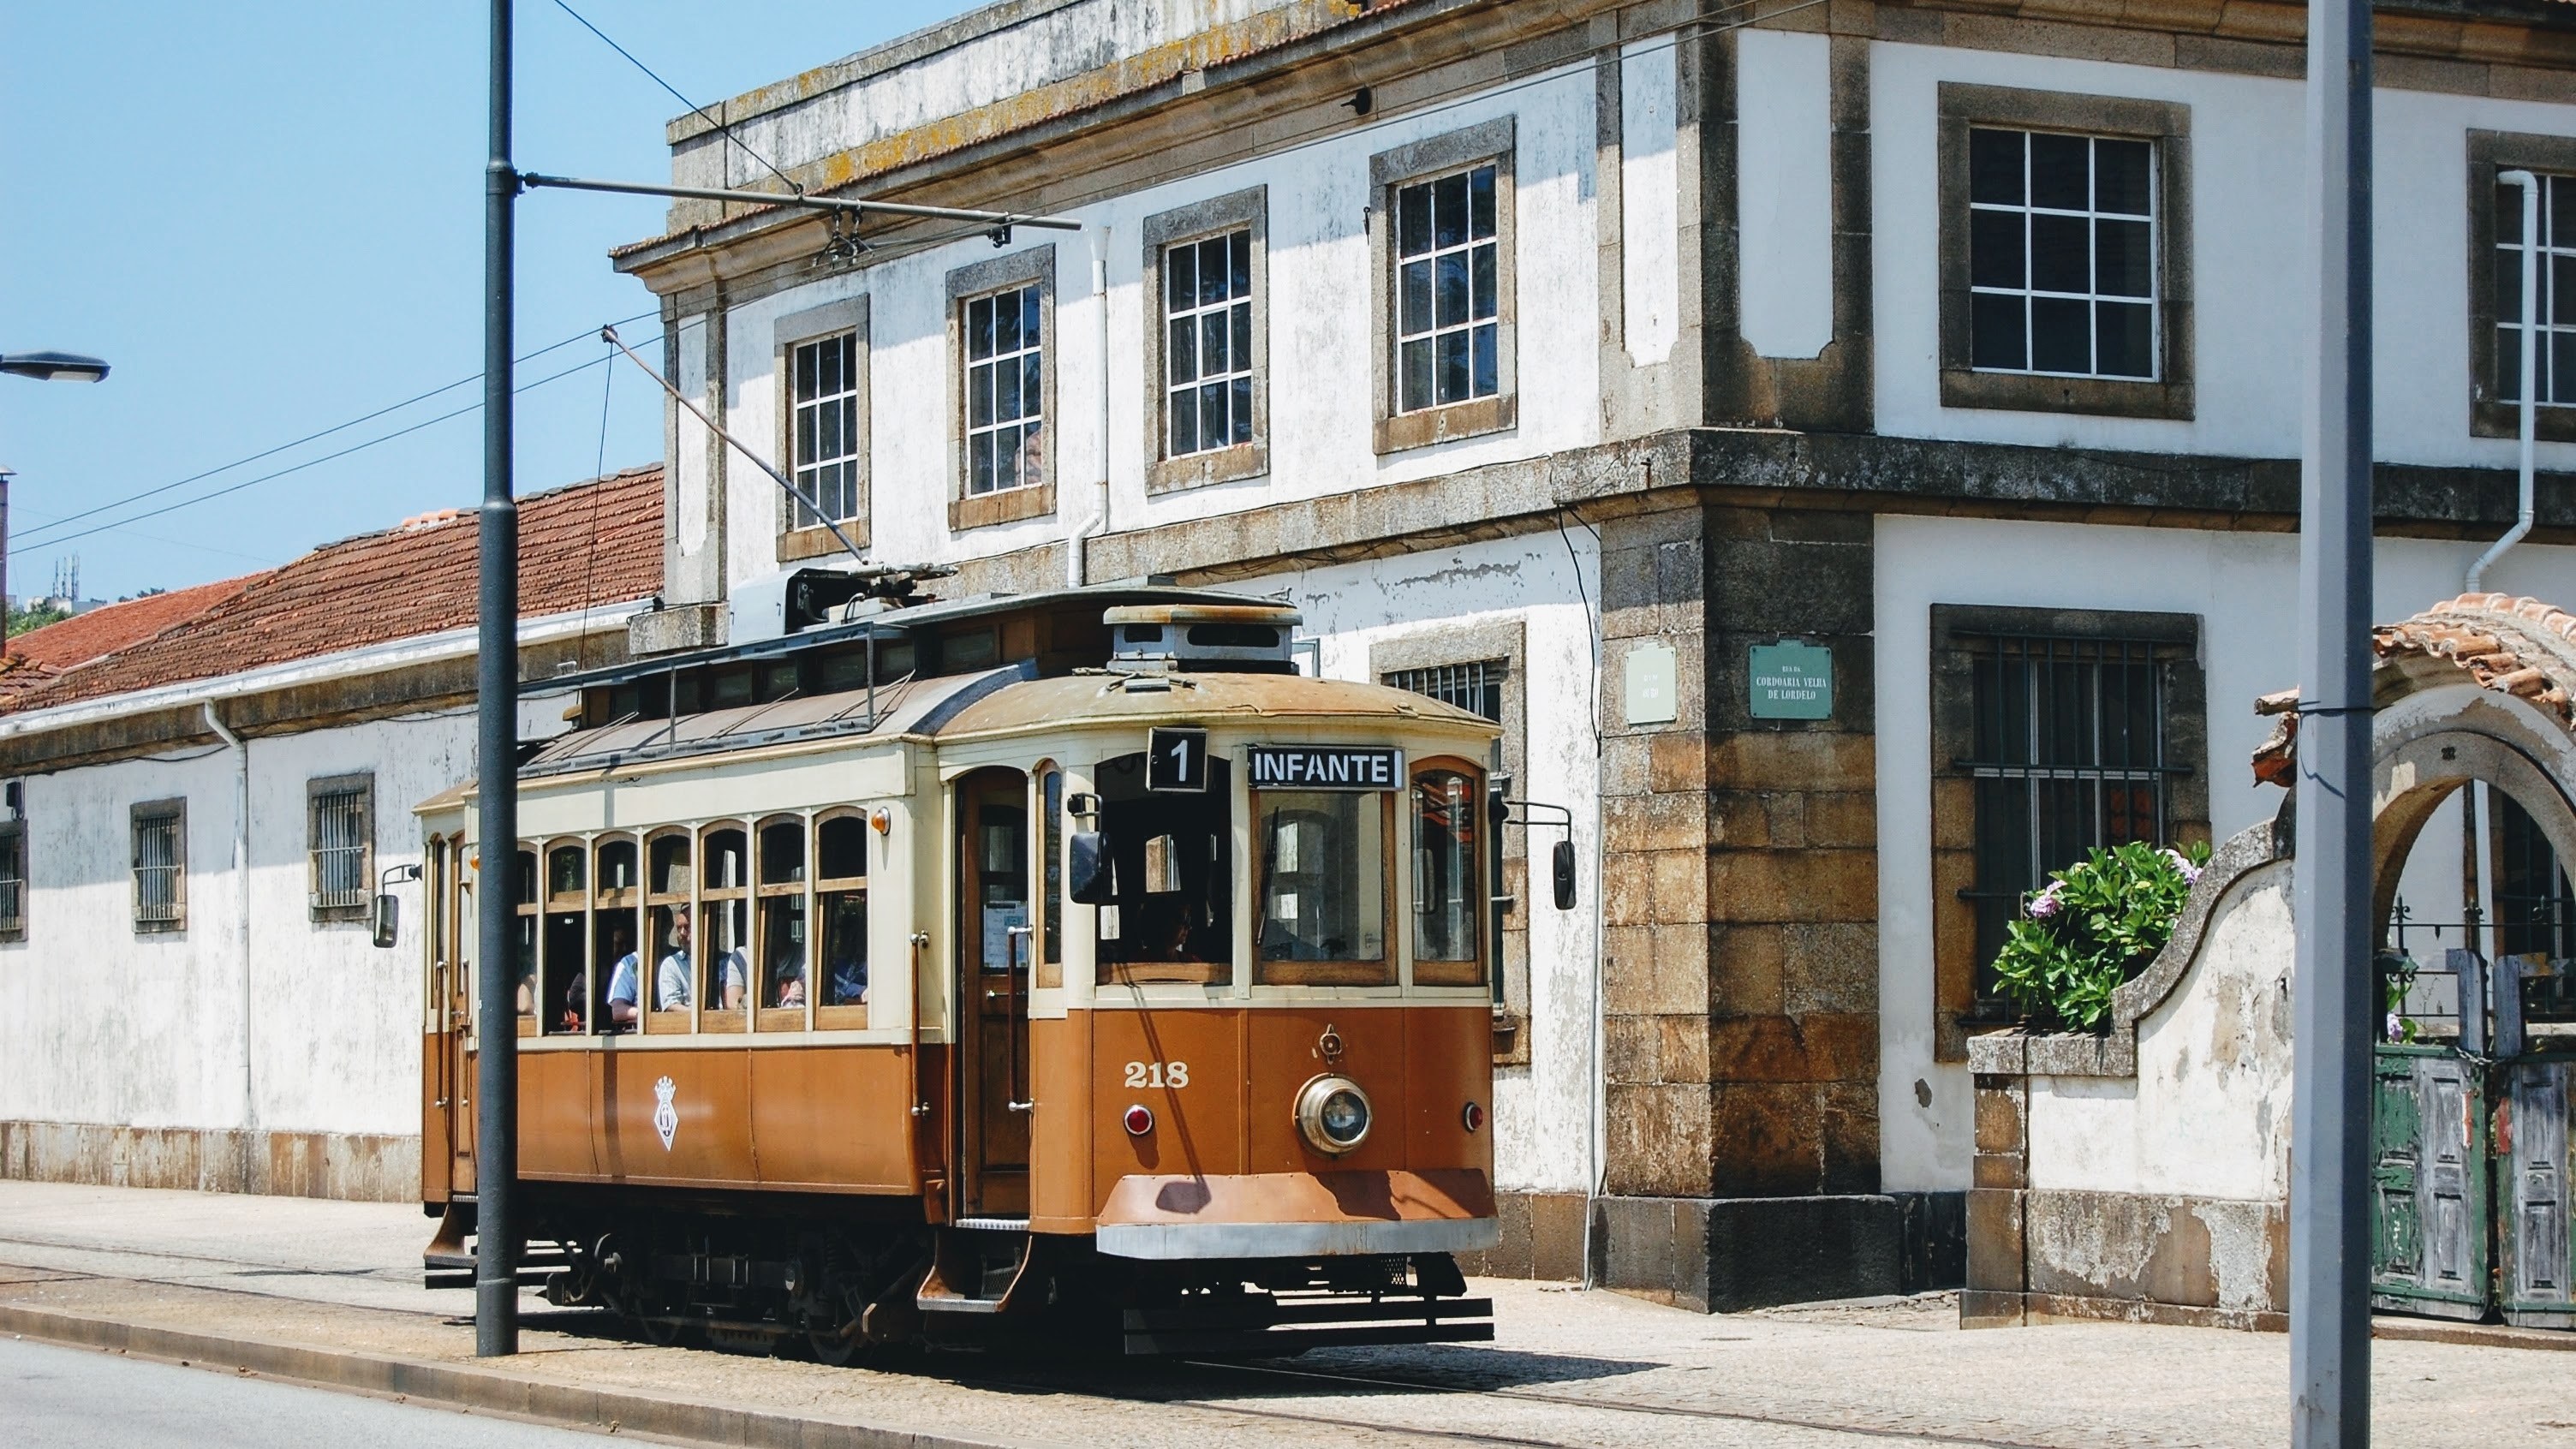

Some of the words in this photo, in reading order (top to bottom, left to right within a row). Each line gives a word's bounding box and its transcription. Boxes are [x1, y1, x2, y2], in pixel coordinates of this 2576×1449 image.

[1756, 677, 1800, 687] CORDOARIA
[1804, 677, 1827, 688] VELHA
[1768, 689, 1779, 700] DE
[1781, 689, 1816, 701] LORDELO
[1171, 739, 1188, 782] 1
[1255, 753, 1388, 783] INFANTE
[1124, 1061, 1190, 1088] 218
